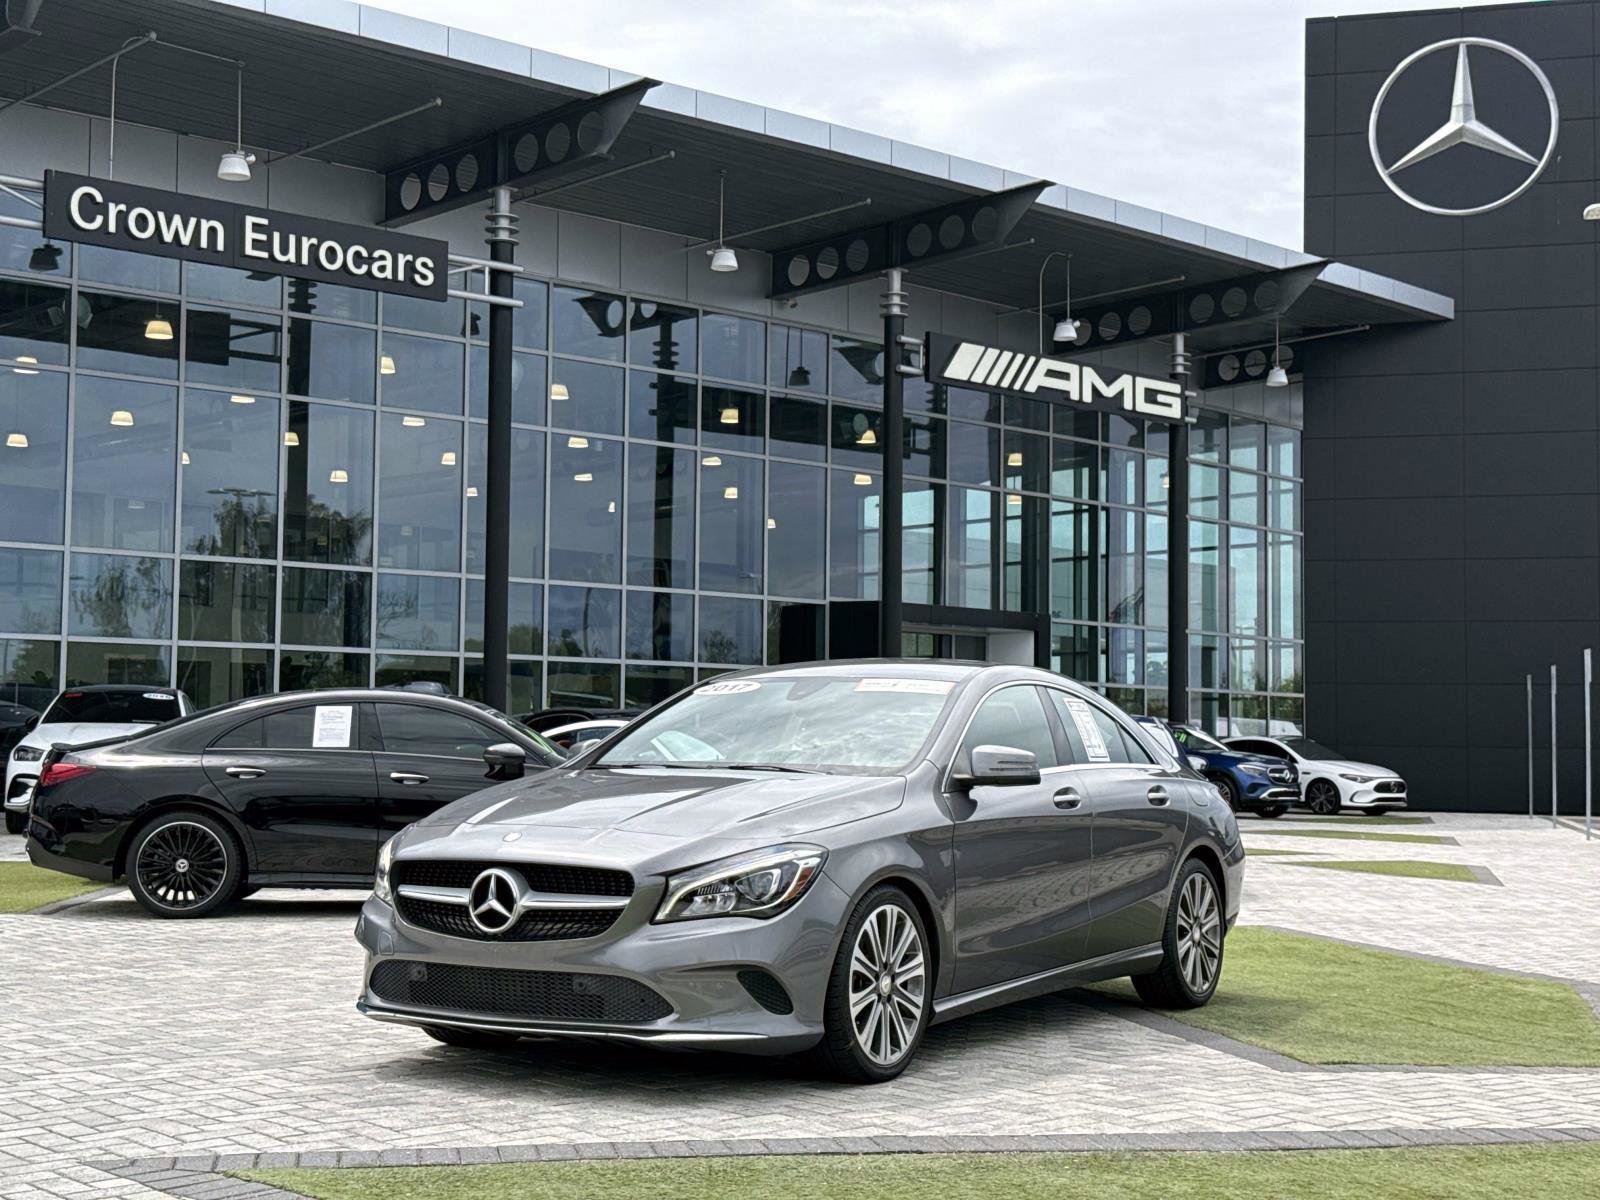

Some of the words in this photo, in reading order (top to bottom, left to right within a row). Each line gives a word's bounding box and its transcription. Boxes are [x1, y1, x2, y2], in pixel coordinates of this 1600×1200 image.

[69, 185, 225, 253] Crown
[243, 214, 435, 288] Eurocars
[1023, 357, 1182, 419] AMG
[699, 682, 755, 693] 2017
